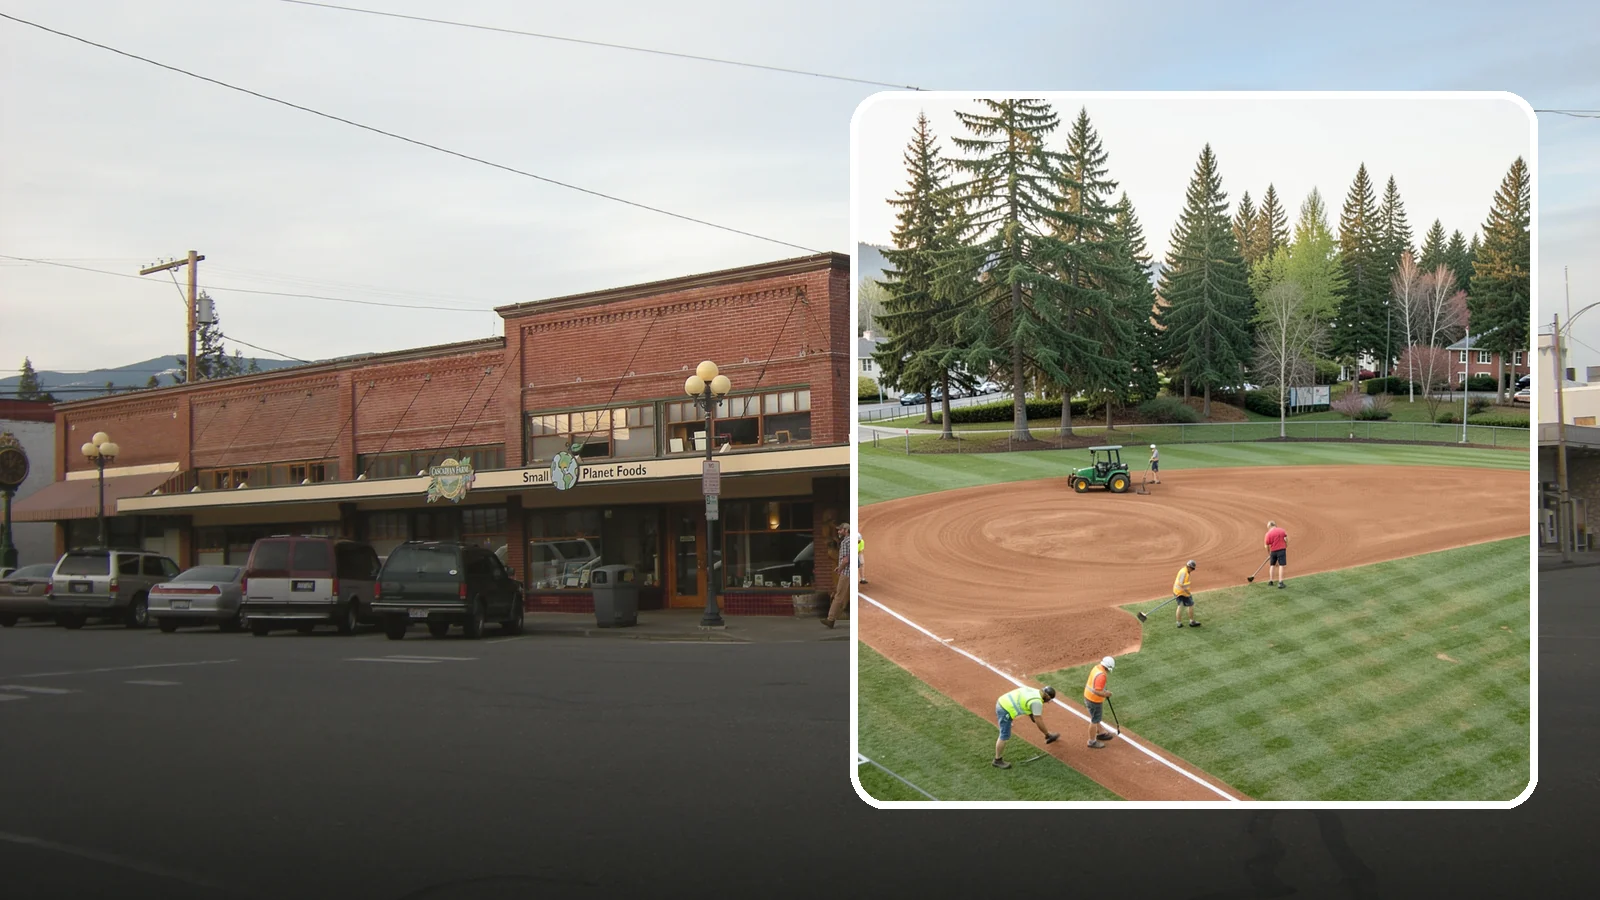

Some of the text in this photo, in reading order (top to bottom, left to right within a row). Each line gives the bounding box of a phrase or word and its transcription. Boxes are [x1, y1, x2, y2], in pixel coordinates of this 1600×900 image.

[523, 464, 647, 483] Small Planet Foods
